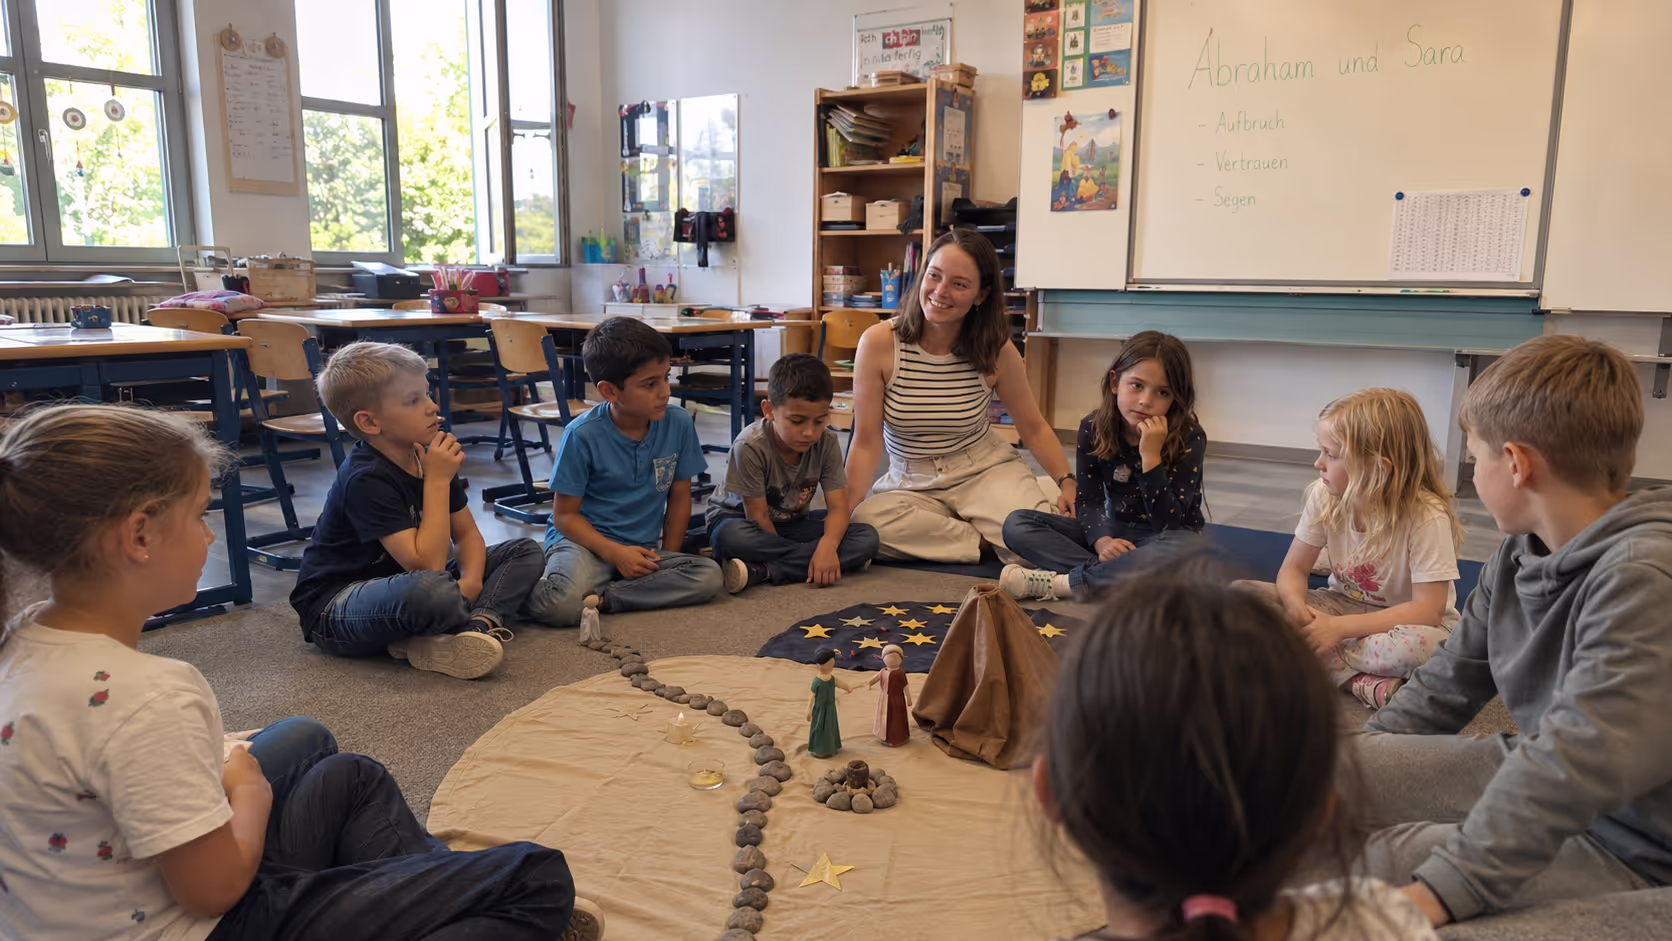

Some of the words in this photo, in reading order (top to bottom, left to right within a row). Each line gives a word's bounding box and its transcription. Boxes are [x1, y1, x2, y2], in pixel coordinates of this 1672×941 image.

[1338, 40, 1379, 76] und
[1404, 23, 1466, 68] Sara
[1215, 108, 1285, 134] Aufbruch
[1215, 149, 1288, 172] Vertrauen
[1213, 185, 1256, 214] Segen
